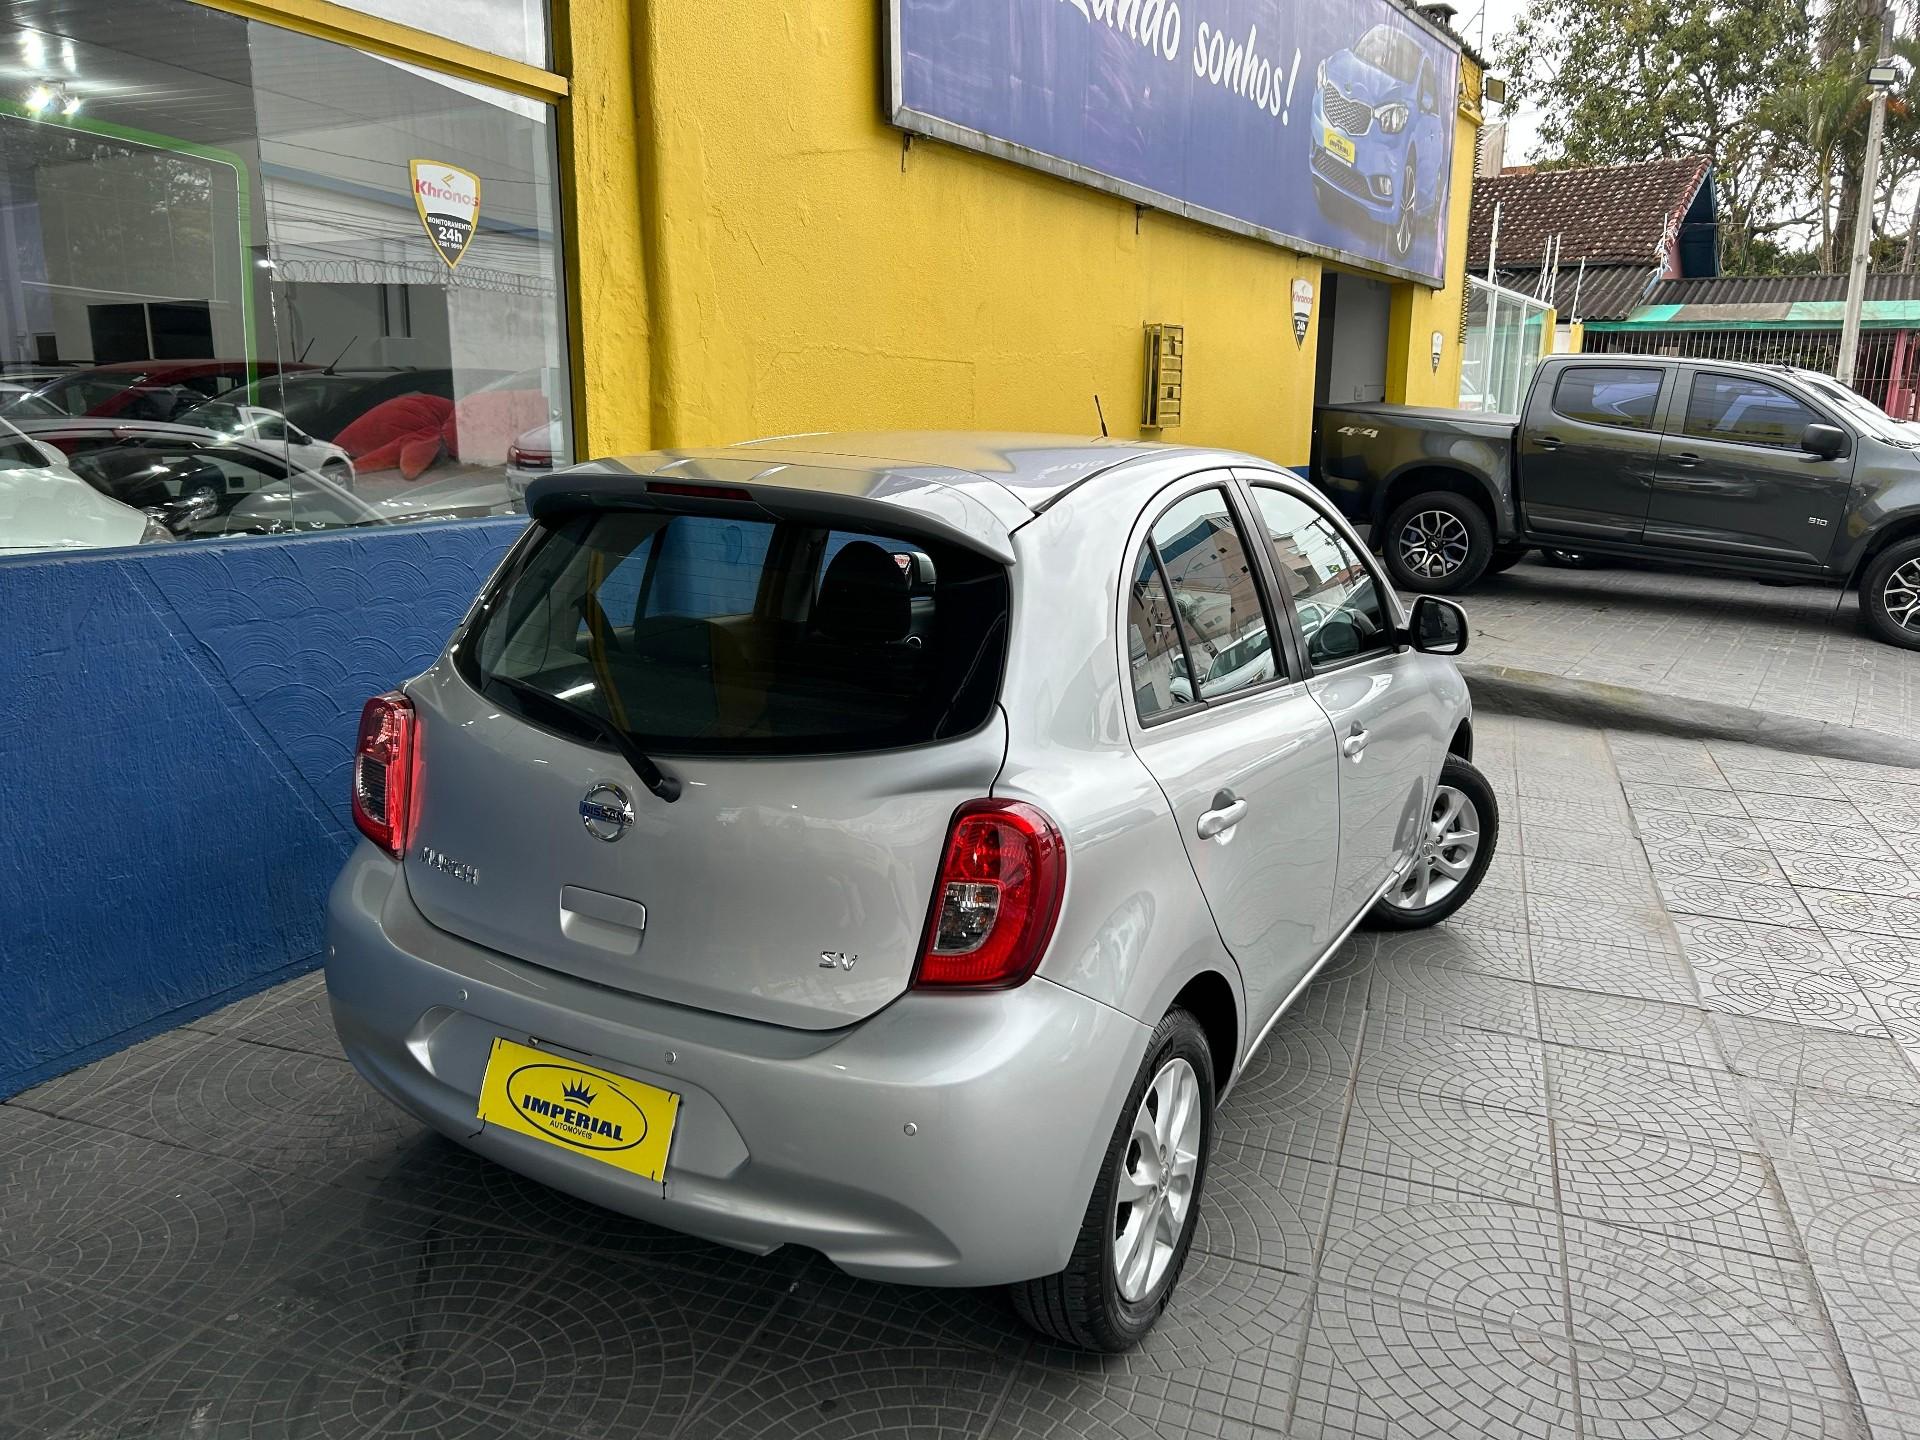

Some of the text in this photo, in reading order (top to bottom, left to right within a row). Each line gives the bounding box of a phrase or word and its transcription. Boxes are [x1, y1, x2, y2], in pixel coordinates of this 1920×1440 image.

[1193, 21, 1301, 126] sonhos!
[415, 178, 480, 207] Khronos
[427, 215, 472, 231] MONITORAMENTO
[438, 226, 463, 243] 24h
[1808, 516, 1828, 527] S10
[582, 803, 631, 825] NISSAN
[819, 950, 858, 971] SV
[522, 1094, 624, 1142] IMPERIAL
